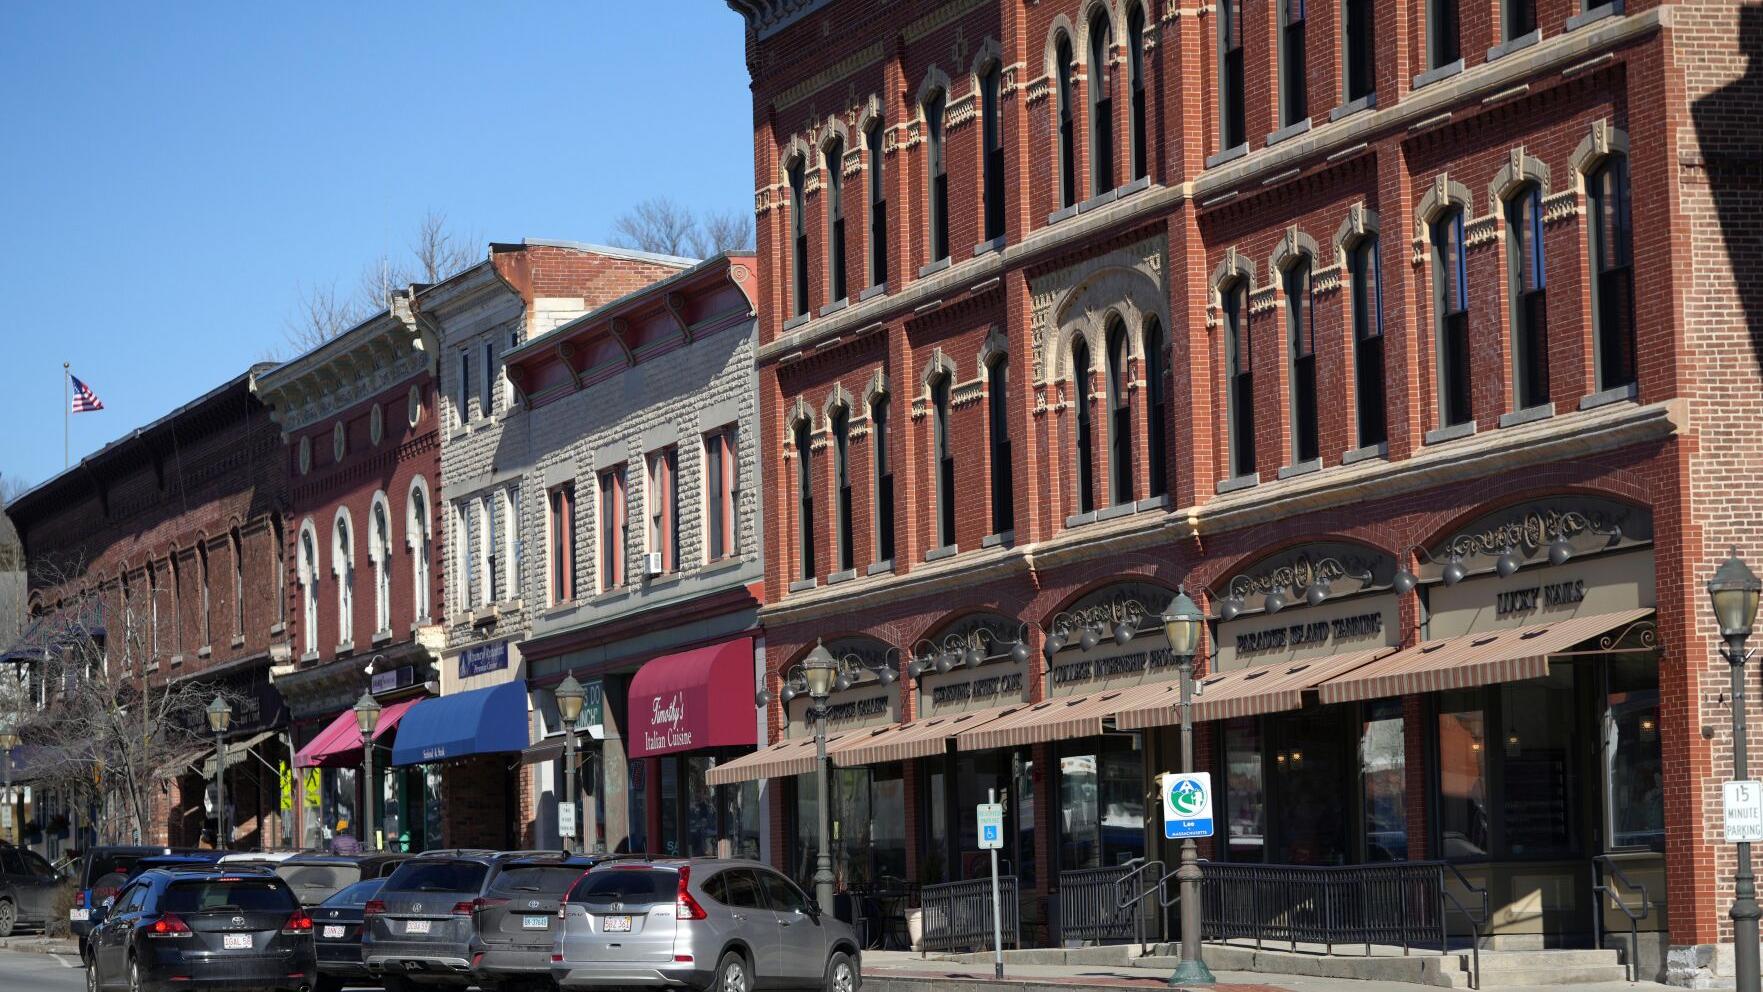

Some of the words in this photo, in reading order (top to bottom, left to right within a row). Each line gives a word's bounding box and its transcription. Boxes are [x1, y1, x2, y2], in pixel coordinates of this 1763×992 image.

[1497, 587, 1540, 614] LUCKY
[1544, 579, 1584, 607] NAILS
[1235, 628, 1287, 654] PARADISE
[1289, 622, 1329, 646] ISLAND
[1332, 612, 1382, 639] TANNING
[590, 685, 601, 705] DO
[651, 690, 684, 730] Timothy's
[645, 730, 666, 751] Italian
[667, 727, 692, 747] Cuisine
[1735, 784, 1750, 802] 15
[1728, 807, 1760, 819] MINUTE
[1726, 824, 1761, 836] PARKING
